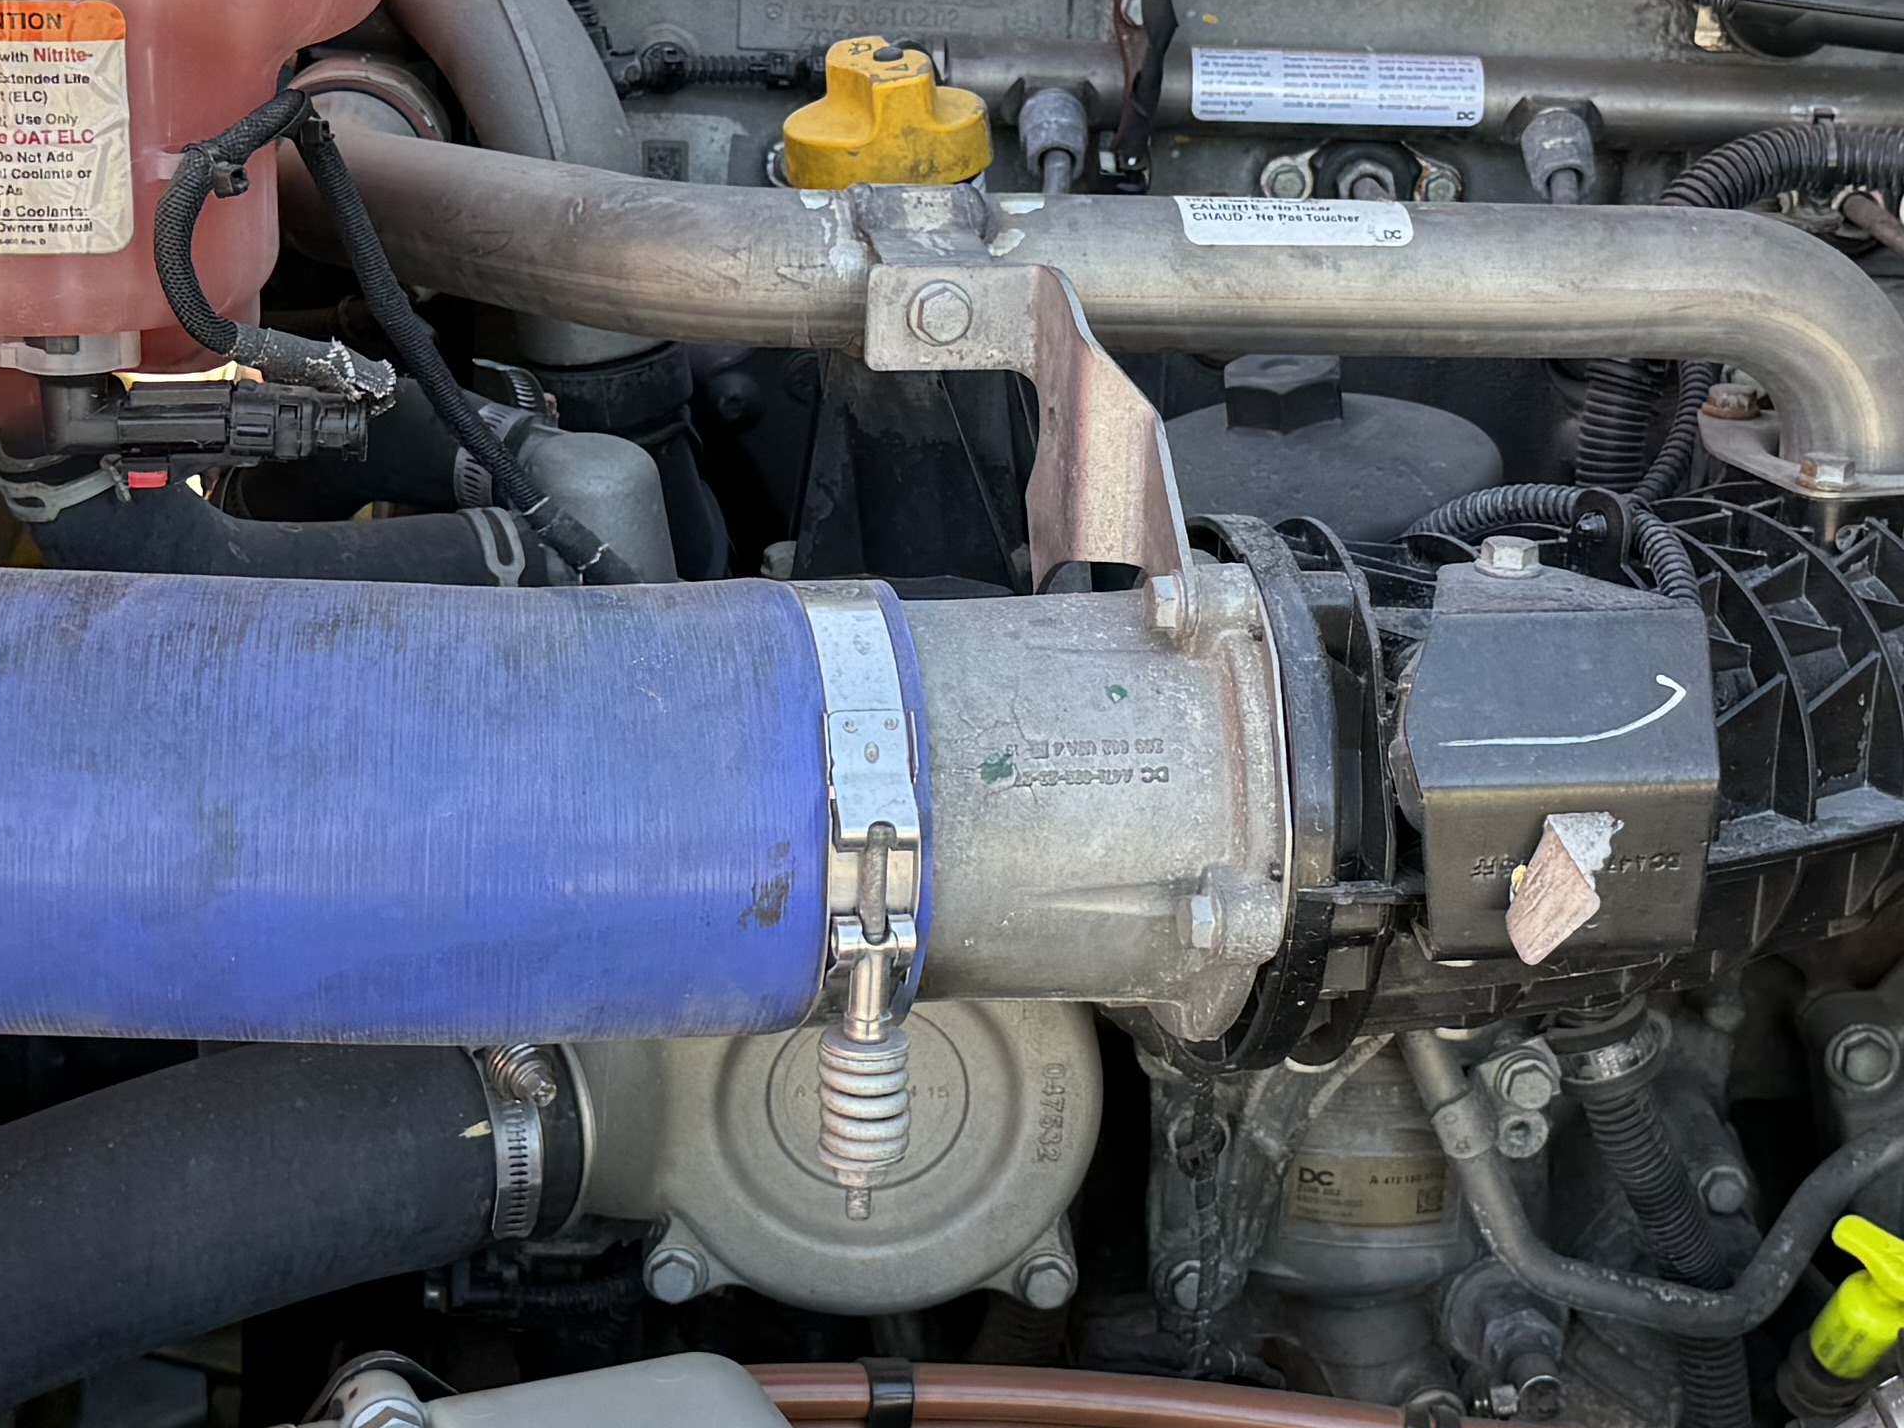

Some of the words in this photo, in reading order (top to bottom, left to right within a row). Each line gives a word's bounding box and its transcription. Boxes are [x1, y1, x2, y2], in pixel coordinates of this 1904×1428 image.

[33, 46, 94, 63] Nitrite-
[64, 73, 90, 85] Life
[8, 89, 48, 105] (ELC)
[14, 114, 42, 126] Use
[45, 113, 79, 127] Only
[12, 128, 51, 145] OAT
[58, 128, 95, 144] ELC
[16, 151, 42, 164] Not
[45, 151, 74, 162] Add
[76, 169, 92, 179] or
[15, 205, 88, 218] Coolants:
[1192, 212, 1243, 222] CHAUD
[1305, 213, 1360, 223] Toucher
[47, 221, 94, 233] Manual
[1384, 230, 1402, 240] DC
[1298, 1166, 1335, 1186] DC
